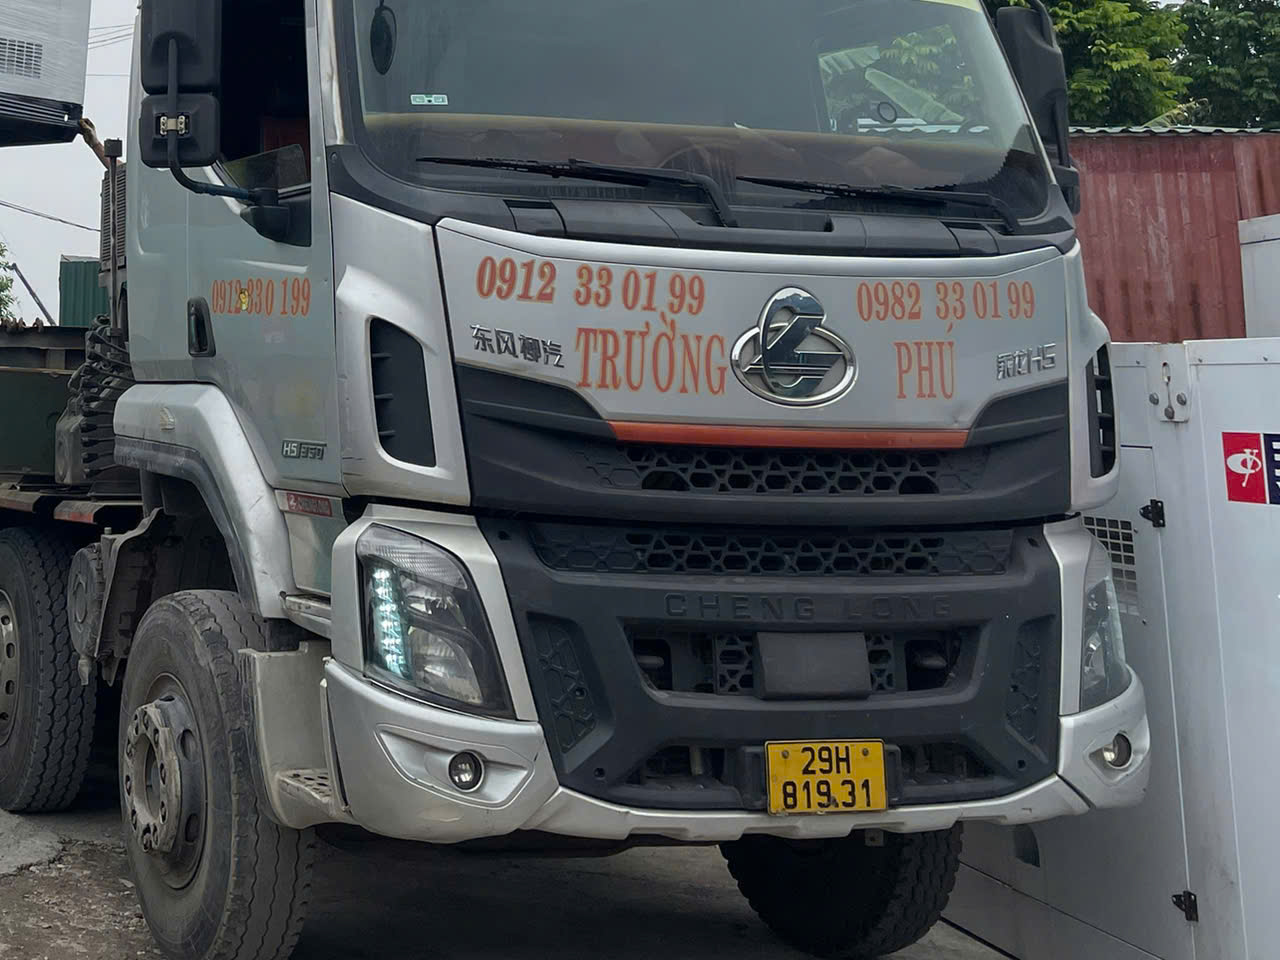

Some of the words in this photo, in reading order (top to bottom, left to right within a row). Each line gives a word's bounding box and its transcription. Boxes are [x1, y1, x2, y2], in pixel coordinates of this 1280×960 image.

[280, 277, 311, 316] 199
[477, 255, 557, 303] 0912
[574, 264, 614, 308] 33
[622, 269, 657, 312] 01
[669, 272, 706, 315] 99
[857, 281, 922, 322] 0982
[935, 281, 966, 321] 33
[973, 281, 1002, 320] 01
[1007, 281, 1036, 320] 99
[575, 311, 728, 396] TRƯỜNG
[894, 321, 955, 400] PHÚ
[664, 592, 815, 621] CHENG
[843, 595, 951, 620] LONG
[801, 746, 851, 775] 29H
